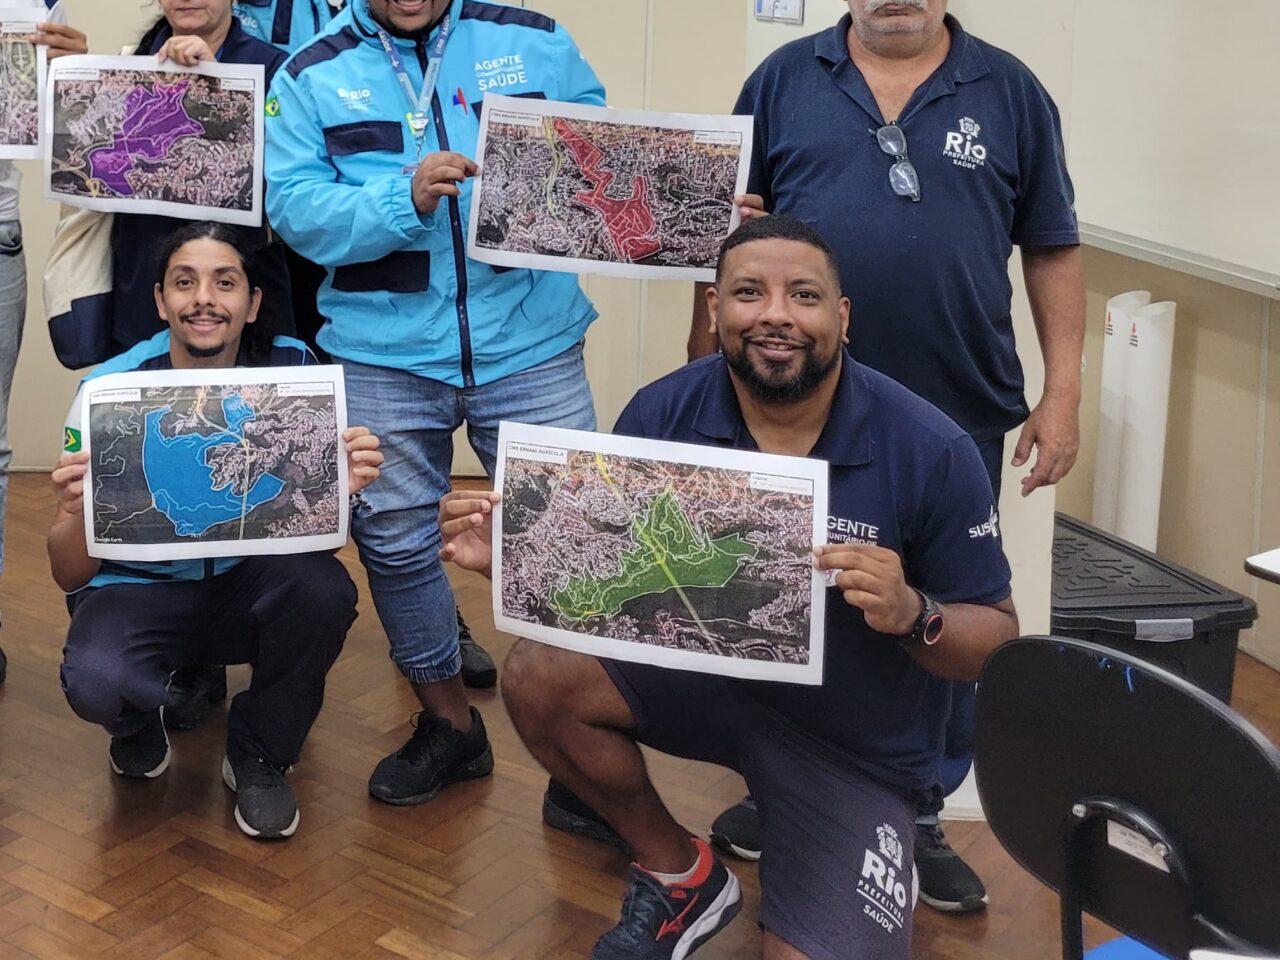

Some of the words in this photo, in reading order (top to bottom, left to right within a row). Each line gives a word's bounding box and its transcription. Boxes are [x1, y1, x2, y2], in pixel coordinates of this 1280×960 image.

[474, 54, 523, 72] AGENTE
[478, 71, 528, 91] SAÚDE
[944, 131, 988, 160] Rio
[942, 149, 986, 167] PREFEITURA
[952, 158, 978, 171] SAÚDE
[827, 515, 880, 539] GENTE
[968, 521, 991, 539] SUS
[861, 848, 907, 909] Rio
[863, 904, 895, 934] SAÚDE
